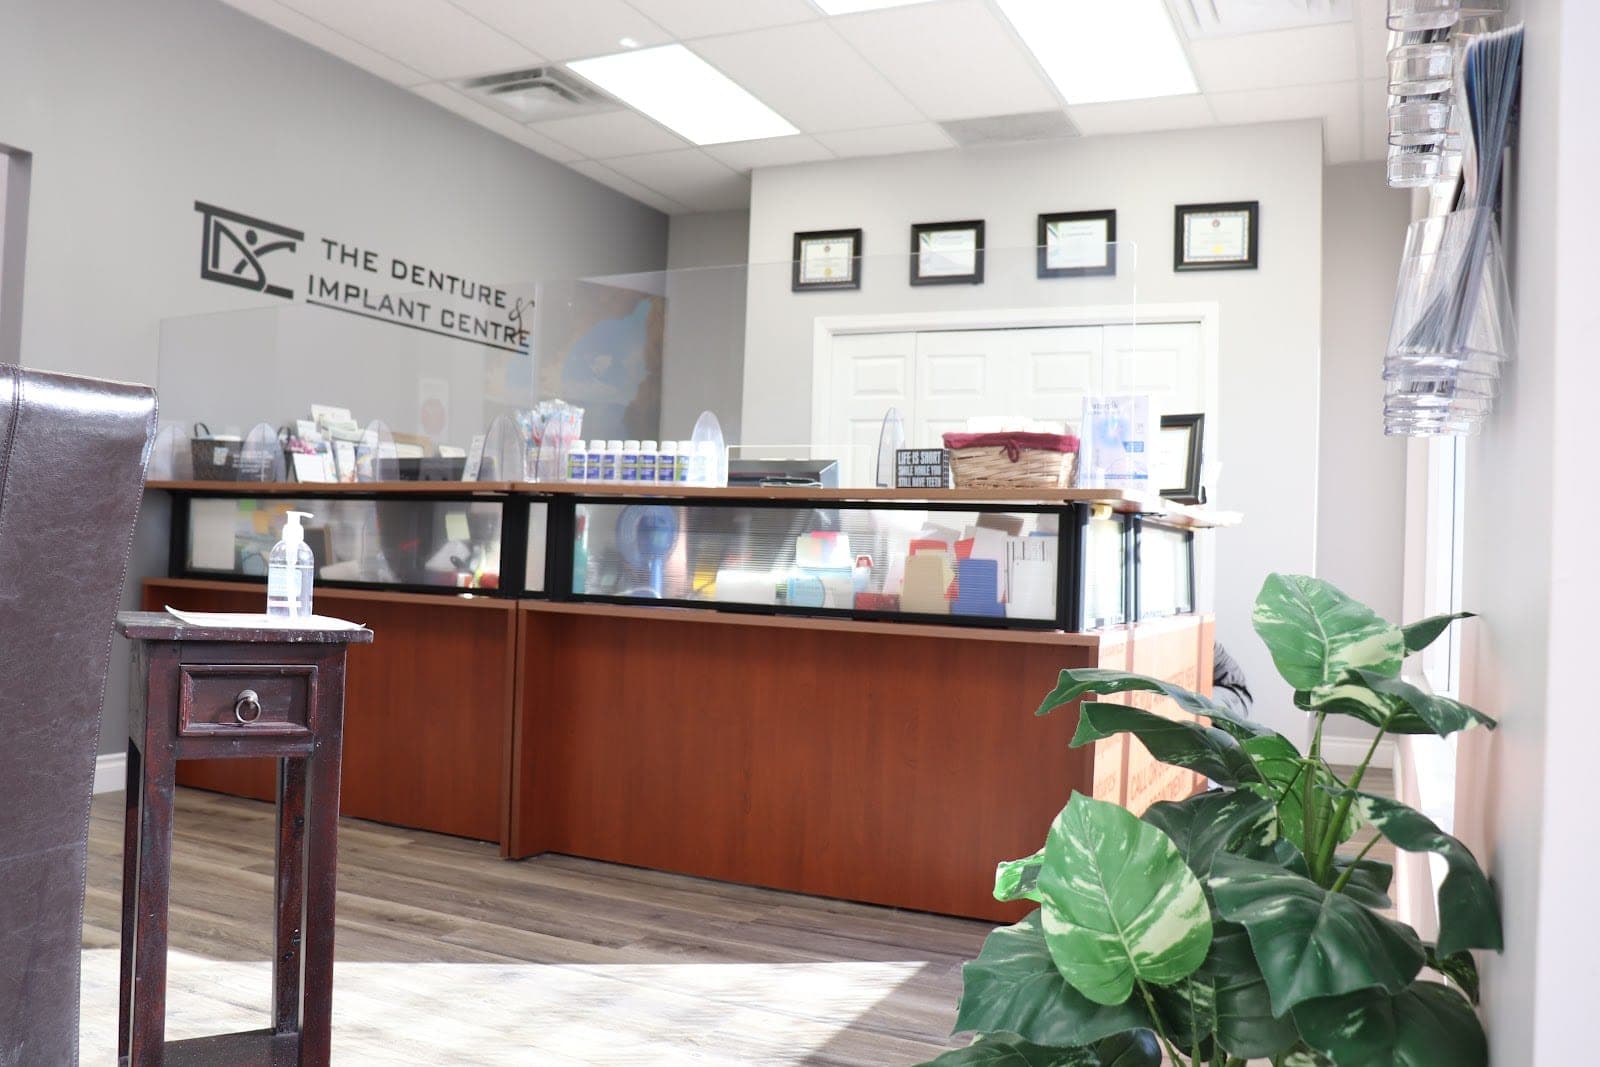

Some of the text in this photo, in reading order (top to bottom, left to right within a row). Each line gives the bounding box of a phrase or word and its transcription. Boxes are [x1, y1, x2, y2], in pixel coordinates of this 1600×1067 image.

[321, 237, 378, 273] THE
[391, 258, 507, 309] DENTURE
[308, 274, 530, 348] IMPLANT CENTRE
[898, 451, 911, 464] LIFE
[912, 451, 920, 464] IS
